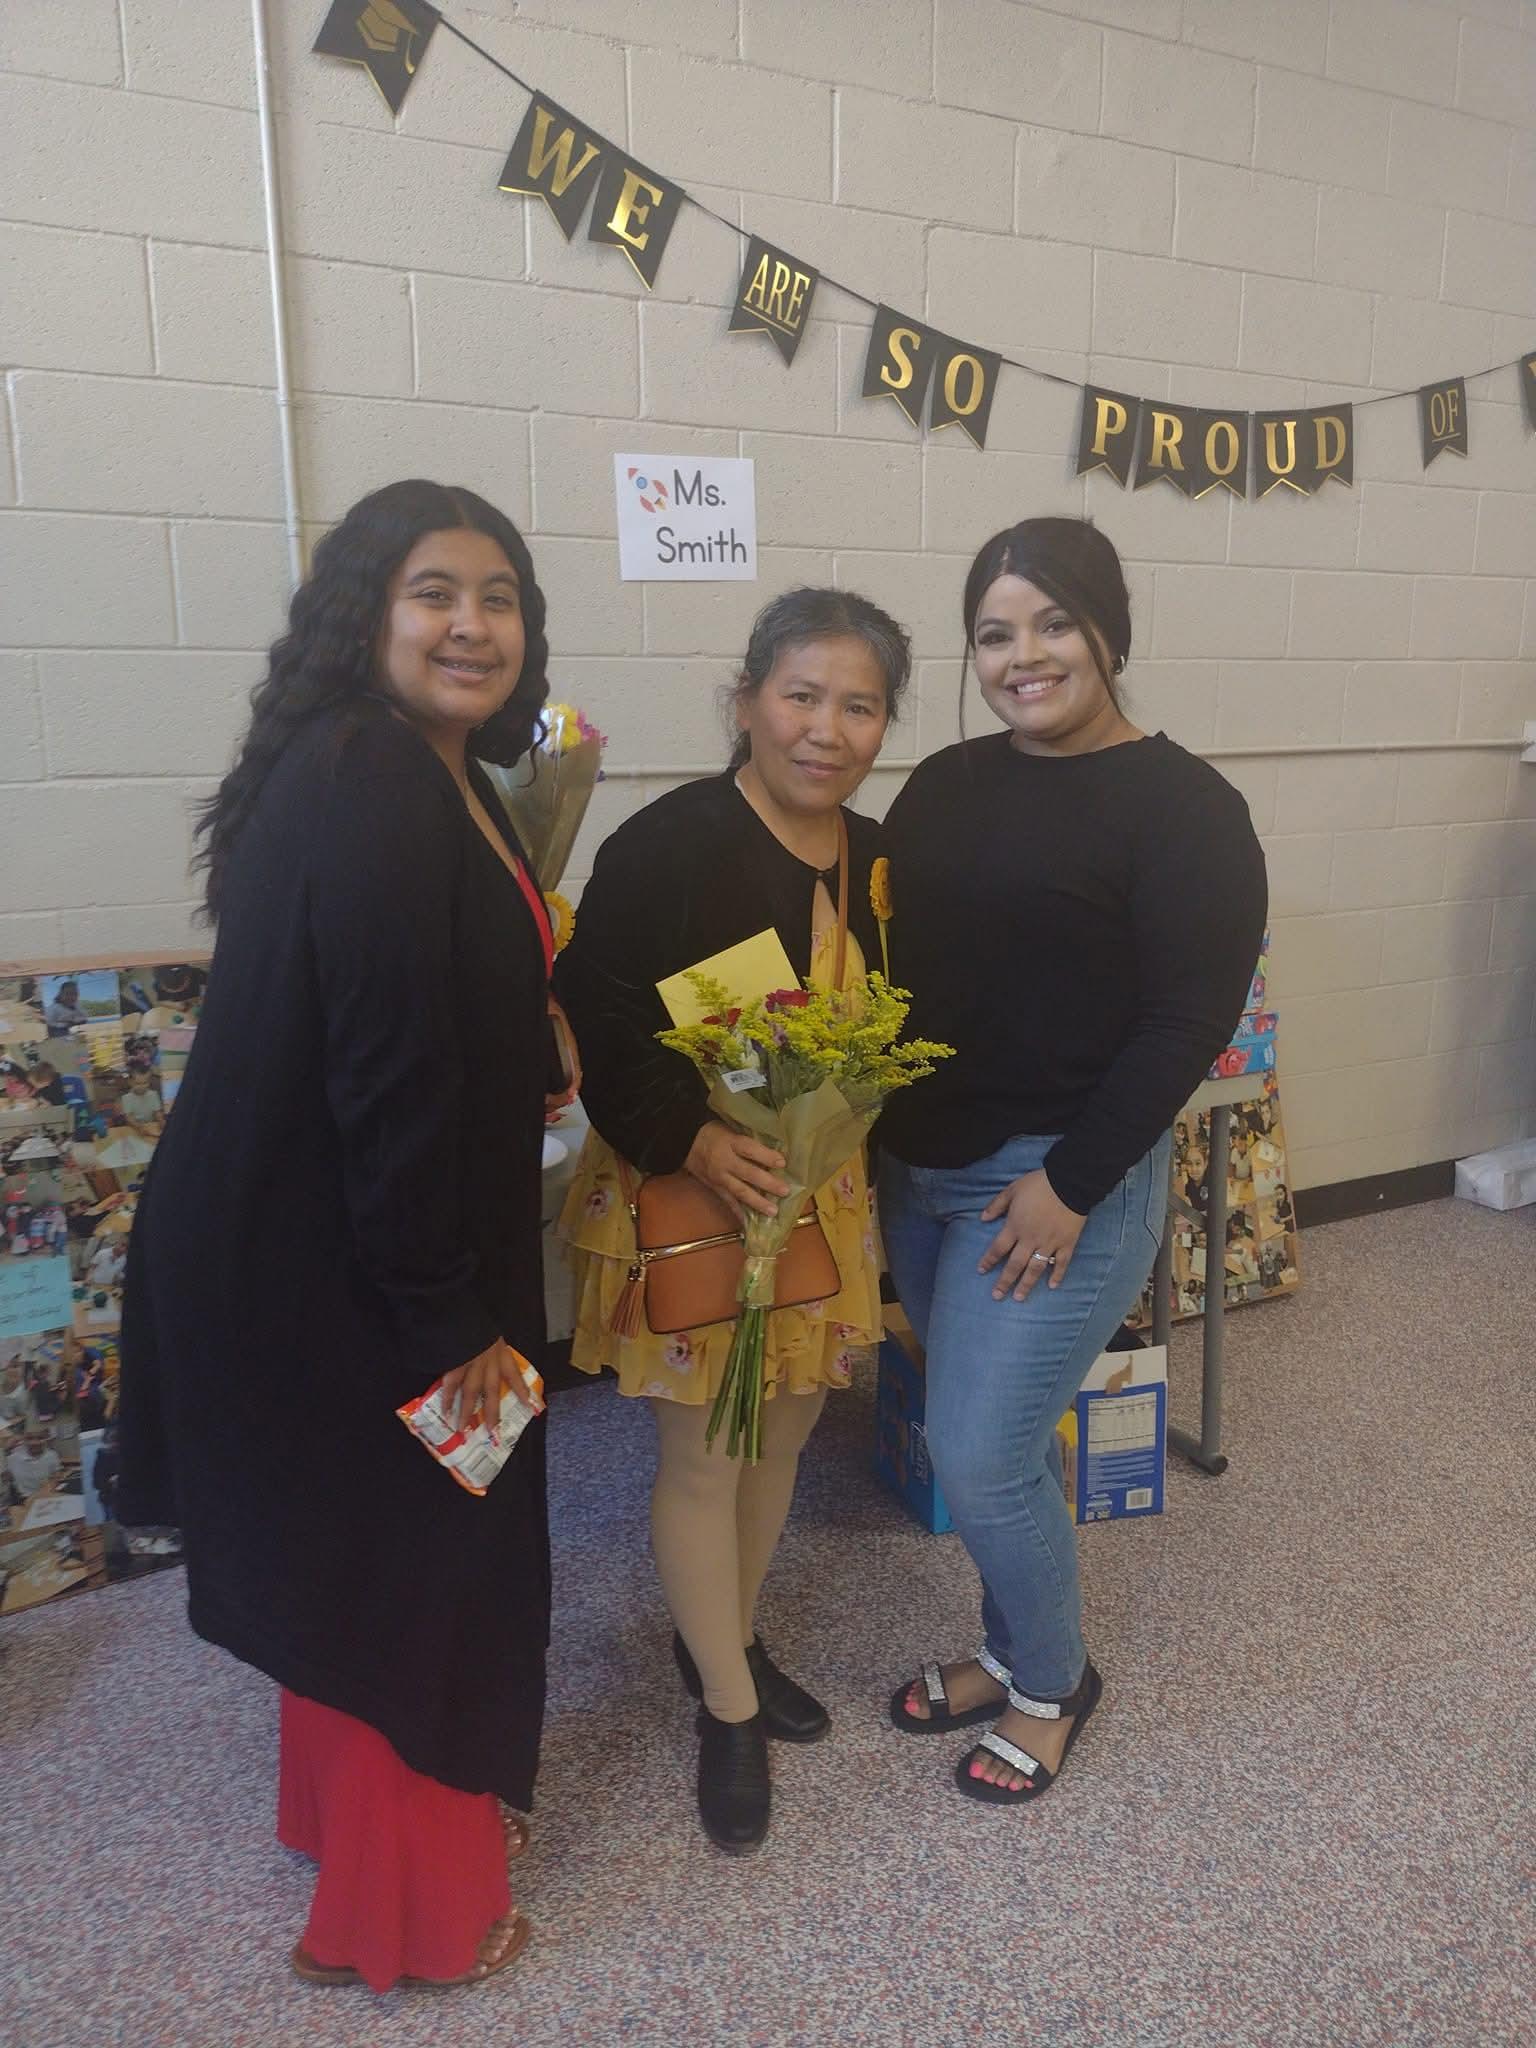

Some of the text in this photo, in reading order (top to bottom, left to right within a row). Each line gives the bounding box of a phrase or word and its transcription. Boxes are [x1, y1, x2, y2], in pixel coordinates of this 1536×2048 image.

[526, 105, 1462, 476] WE ARE SO PROUD OF
[673, 468, 727, 507] Ms.
[656, 526, 748, 564] Smith
